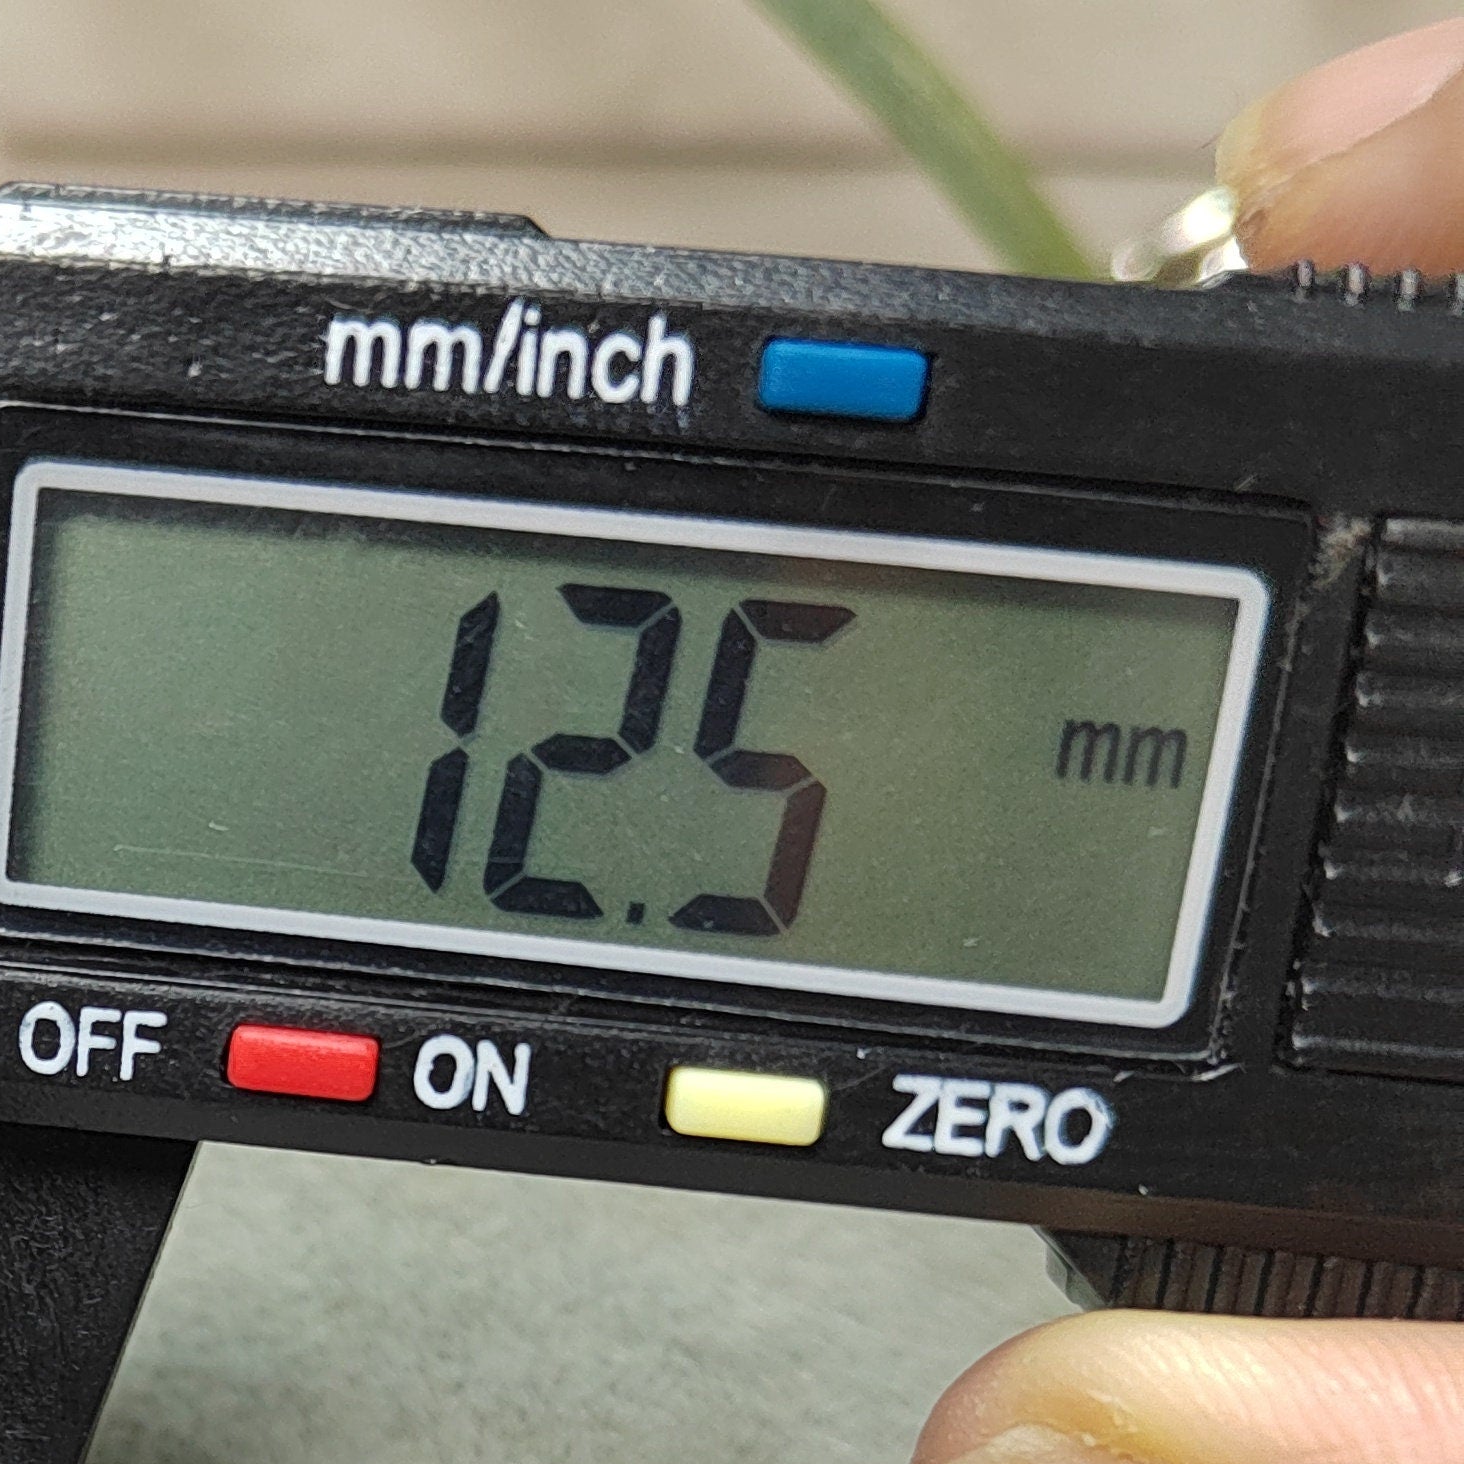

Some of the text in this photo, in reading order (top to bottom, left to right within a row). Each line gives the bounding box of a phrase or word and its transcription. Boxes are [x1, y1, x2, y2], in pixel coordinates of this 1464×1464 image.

[324, 300, 695, 406] mm/inch
[411, 582, 1190, 936] 12.5 mm
[18, 1002, 169, 1081] OFF
[412, 1035, 534, 1117] ON
[881, 1073, 1114, 1166] ZERO
